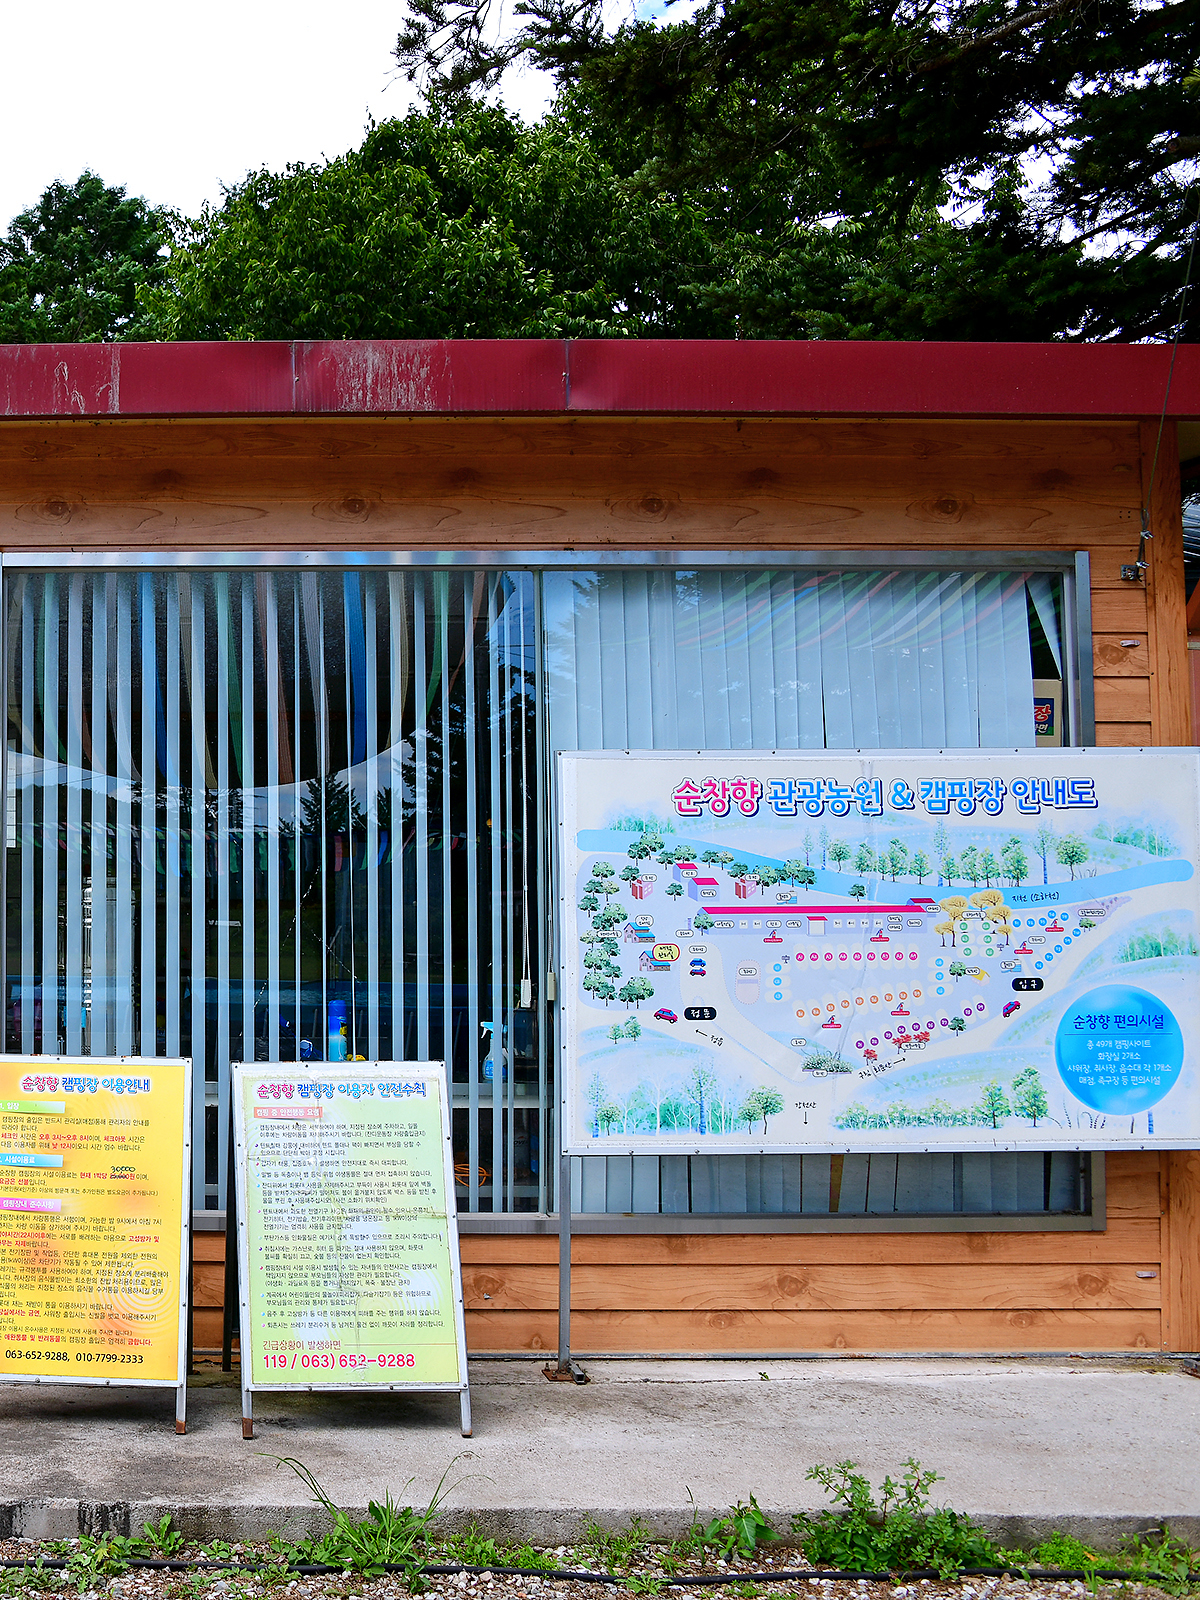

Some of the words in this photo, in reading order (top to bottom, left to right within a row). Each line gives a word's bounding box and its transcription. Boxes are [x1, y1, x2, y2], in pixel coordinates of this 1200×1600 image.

[673, 778, 760, 815] 순창향
[768, 778, 880, 814] 관광농원
[891, 782, 913, 810] &
[919, 777, 1003, 815] 캠핑장
[1011, 778, 1097, 810] 안내도
[1073, 1014, 1111, 1030] 순창향
[1114, 1014, 1164, 1030] 편의시설
[1086, 1040, 1094, 1050] 총
[1096, 1040, 1112, 1048] 49개
[1114, 1040, 1151, 1050] 캠핑사이트
[1097, 1052, 1120, 1062] 화장실
[1121, 1052, 1141, 1061] 2개소
[22, 1075, 59, 1091] 순창향
[61, 1076, 98, 1092] 캠핑장
[102, 1077, 150, 1094] 이용안내
[257, 1083, 295, 1099] 순창향
[297, 1083, 335, 1099] 캠핑장
[337, 1083, 375, 1098] 이용자
[377, 1082, 426, 1098] 안전수칙
[262, 1340, 304, 1350] 긴급상황이
[307, 1340, 341, 1350] 발생하면
[5, 1349, 69, 1362] 063-652-9288,
[75, 1352, 143, 1365] 010-7799-2333
[263, 1354, 286, 1367] 119
[300, 1353, 335, 1369] 063)
[338, 1353, 415, 1367] 652-9288
